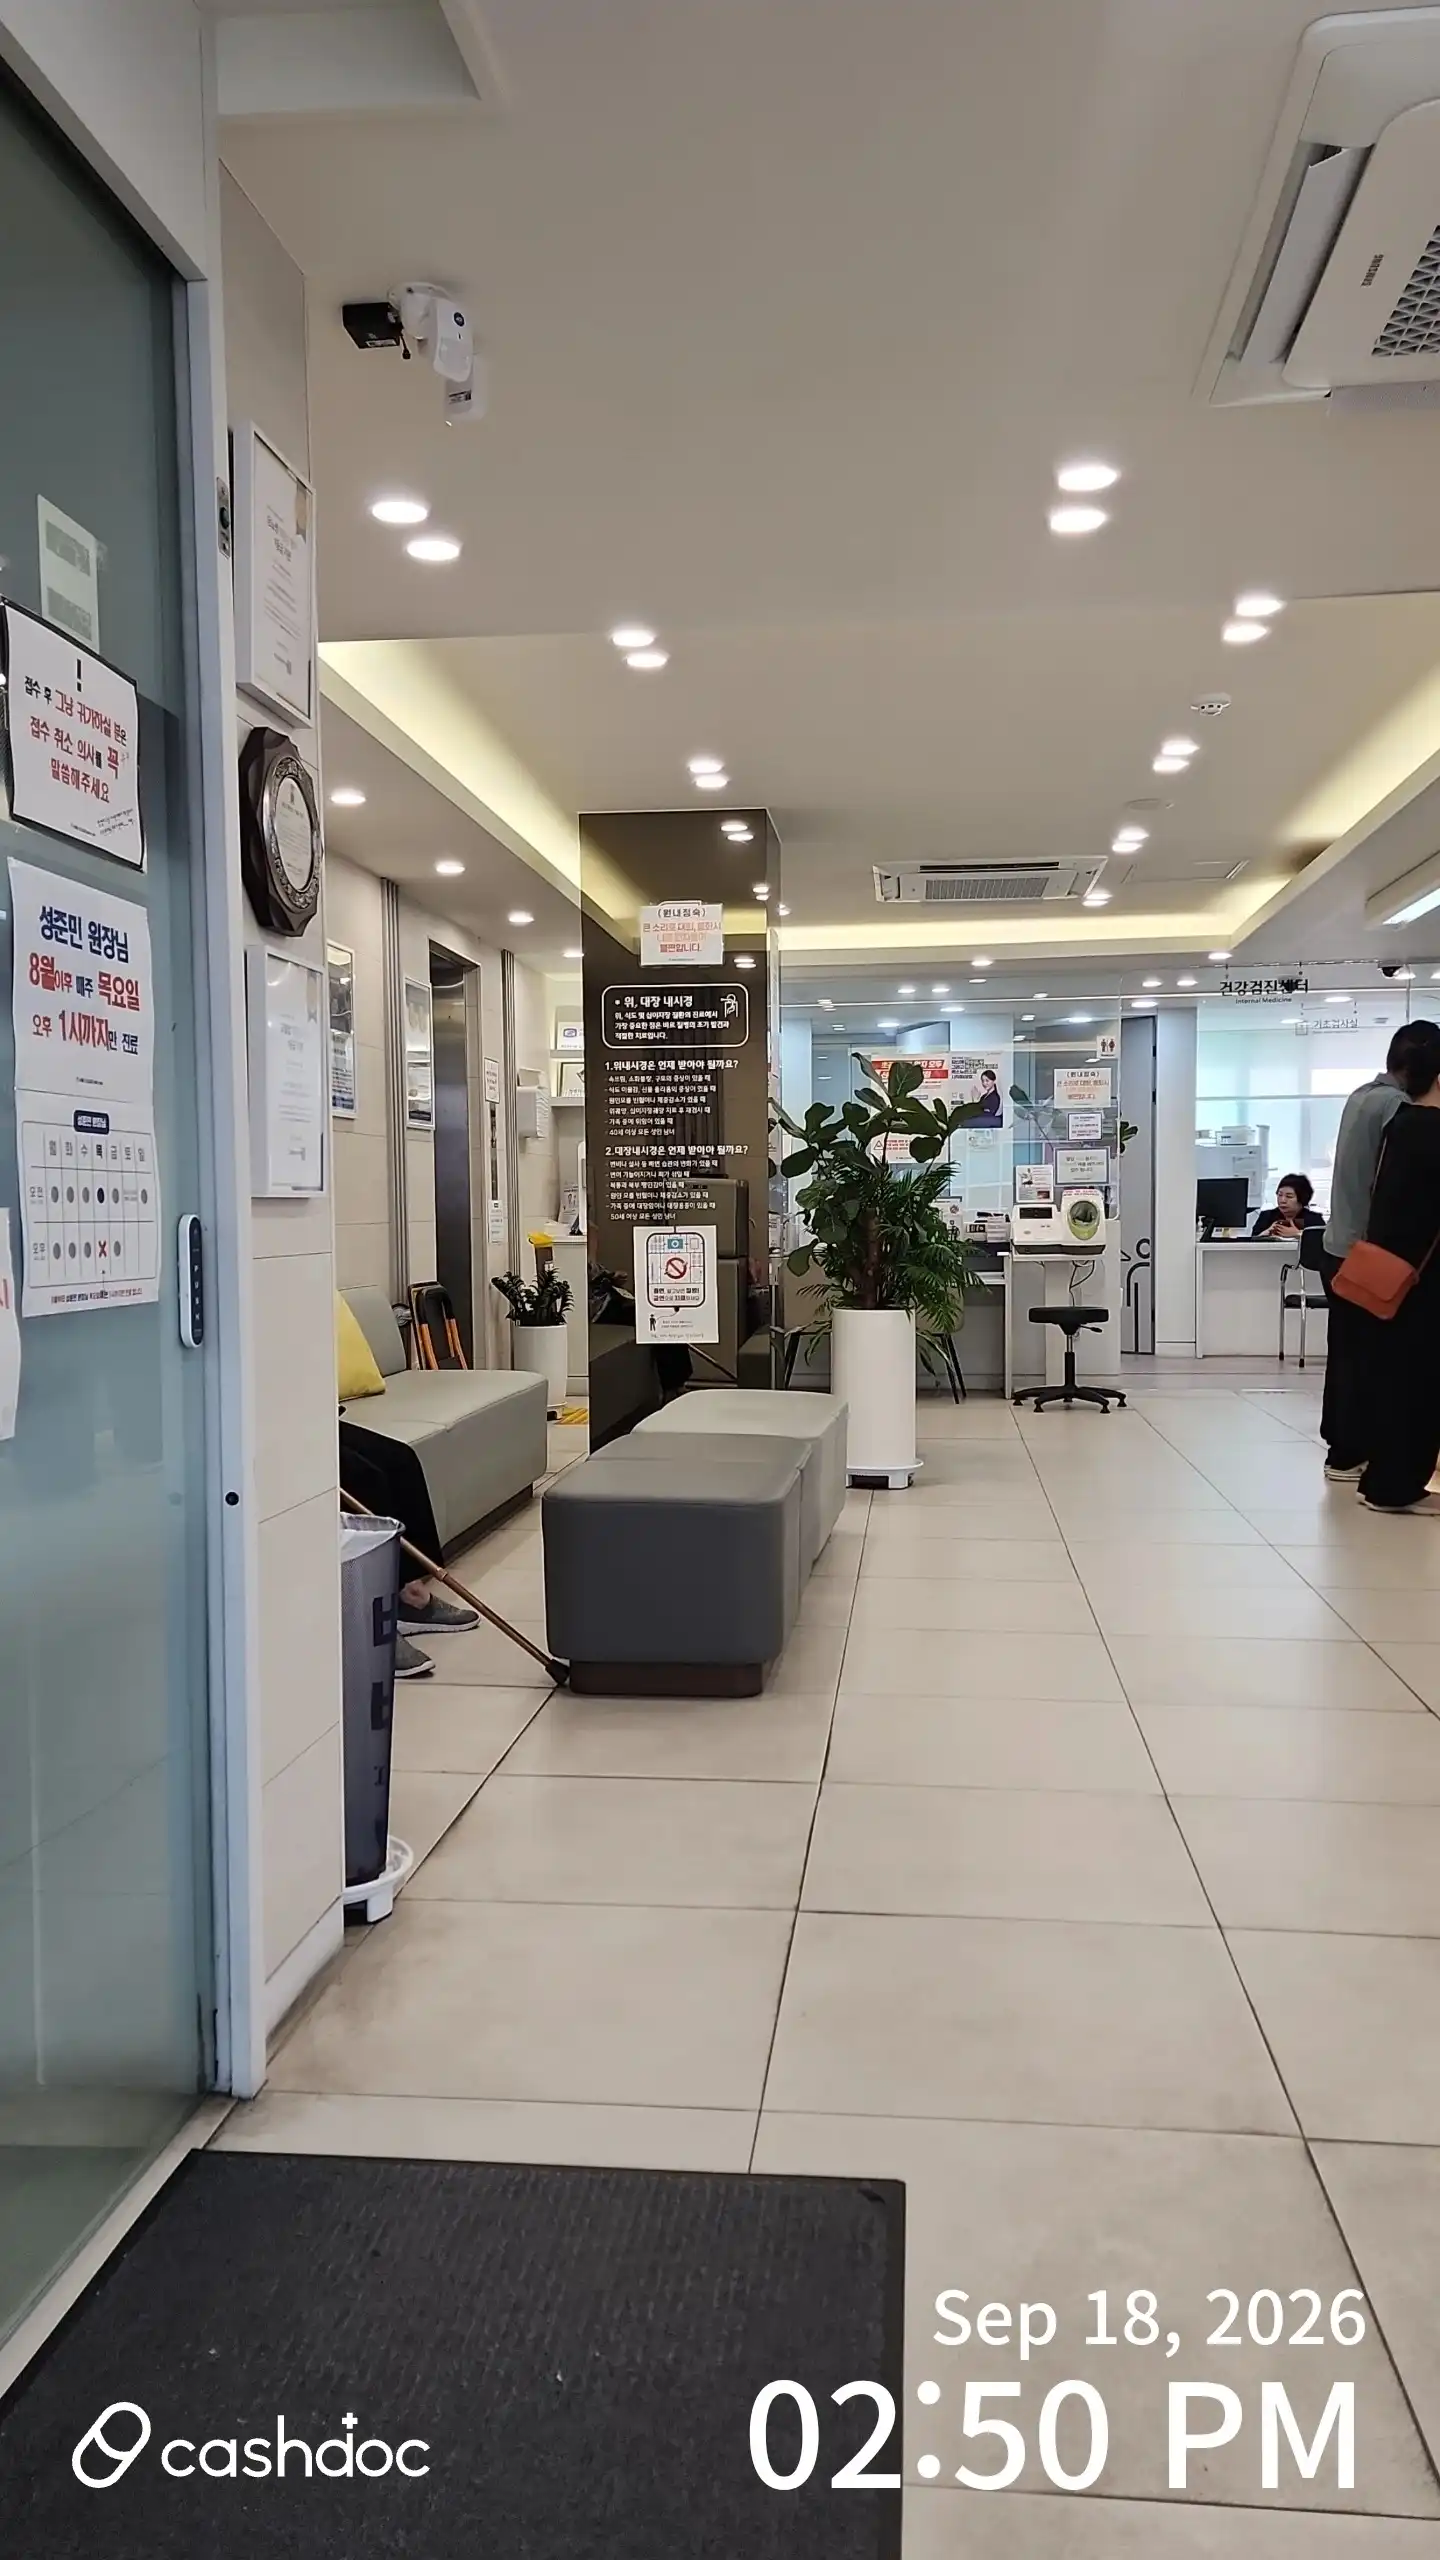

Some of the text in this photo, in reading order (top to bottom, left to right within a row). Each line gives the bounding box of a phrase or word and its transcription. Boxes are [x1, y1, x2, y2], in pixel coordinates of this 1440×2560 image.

[24, 676, 127, 747] 접수 후 그냥 귀가하실 분은
[30, 716, 50, 742] 접수
[54, 727, 73, 755] 취소
[77, 739, 102, 769] 의사를
[107, 746, 119, 780] 꼭
[51, 758, 110, 803] 말씀해주세요
[657, 908, 706, 918] (원내정숙)
[39, 905, 129, 963] 성준민 원장님
[29, 952, 140, 1011] 8월이후 매주 목요일
[624, 996, 693, 1008] 위, 대장 내시경
[1219, 978, 1309, 996] 건강검진센터
[32, 1014, 52, 1038] 오후
[121, 1033, 139, 1055] 진료
[605, 1061, 656, 1070] 1.위내시경은
[658, 1061, 675, 1070] 언제
[678, 1060, 704, 1070] 받아야
[605, 1146, 666, 1155] 2.대장내시경은
[668, 1146, 685, 1155] 언제
[688, 1146, 714, 1155] 받아야
